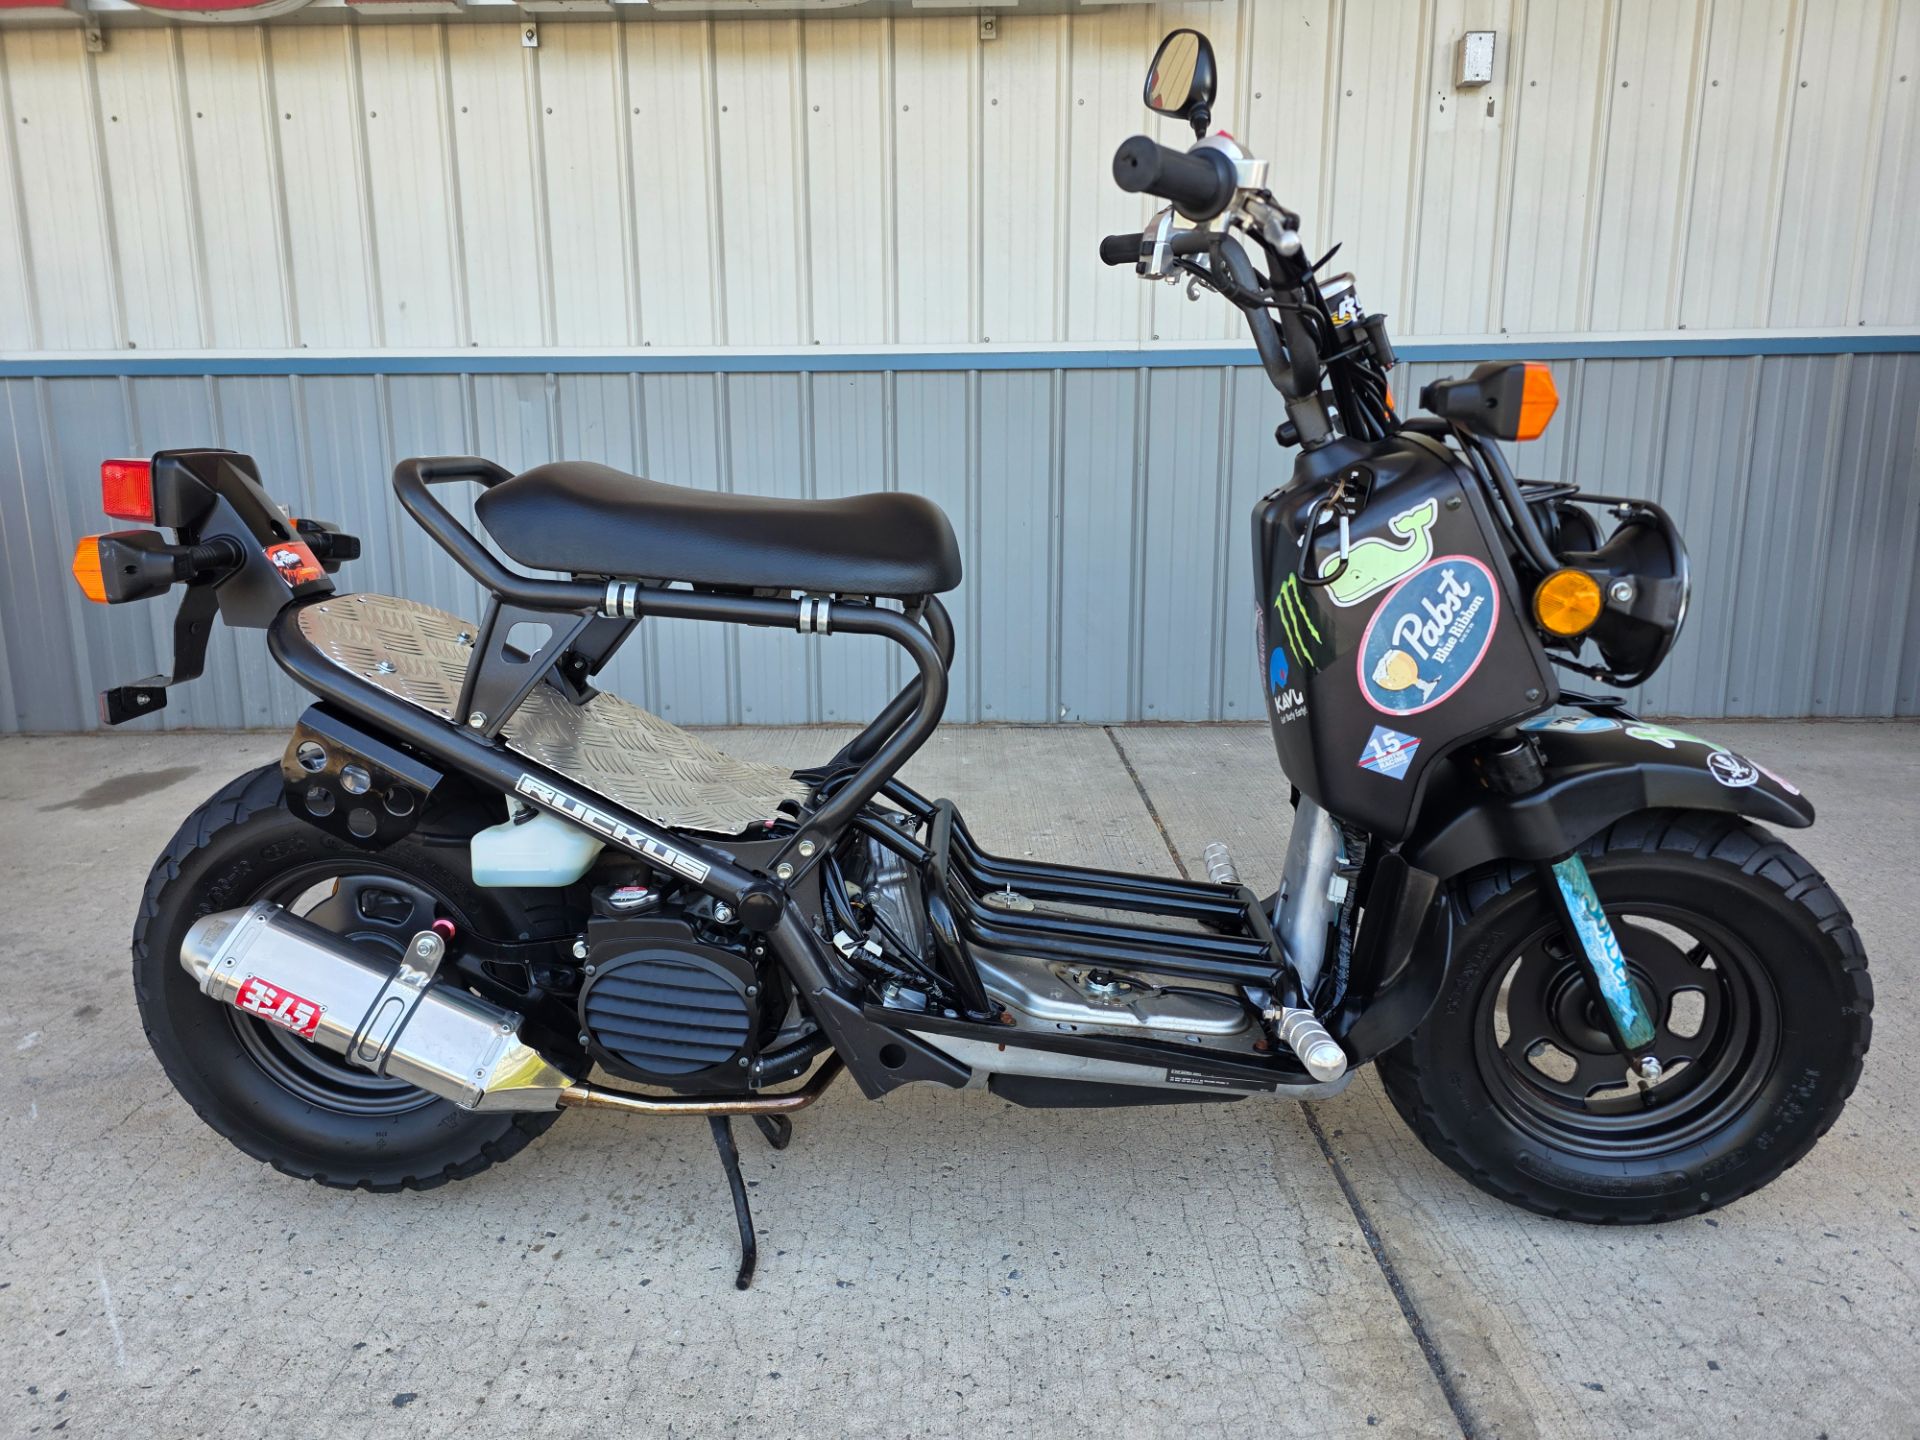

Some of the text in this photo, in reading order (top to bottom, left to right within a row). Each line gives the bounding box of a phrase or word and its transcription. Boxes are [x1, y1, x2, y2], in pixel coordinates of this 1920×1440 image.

[1392, 568, 1471, 661] Pabst
[1431, 595, 1485, 664] Blue Ribbon
[1369, 731, 1401, 759] 15
[520, 778, 708, 880] RUCKUS
